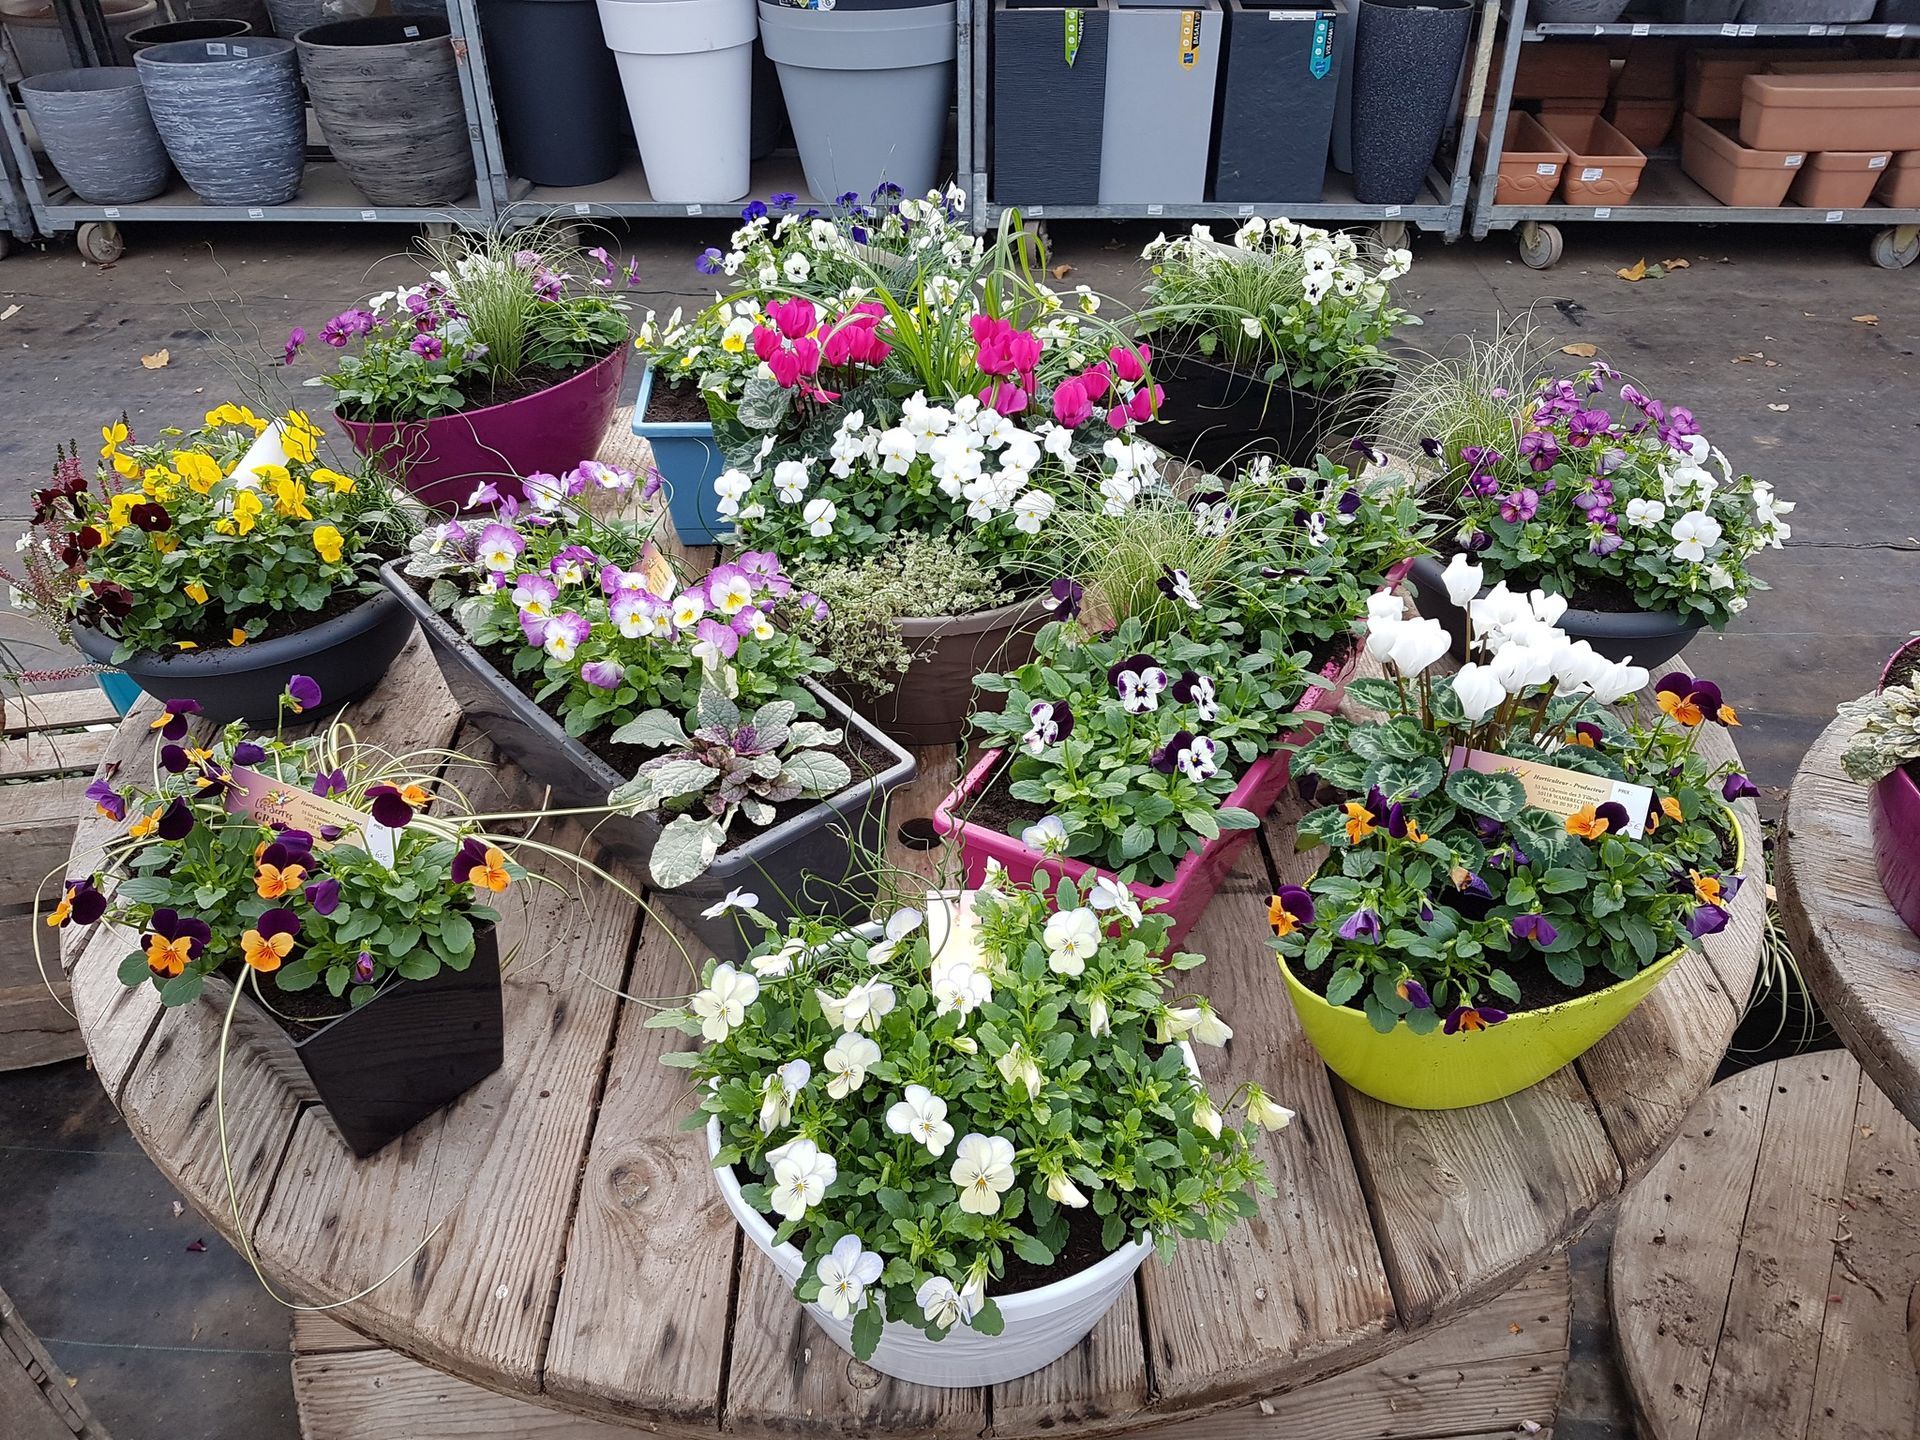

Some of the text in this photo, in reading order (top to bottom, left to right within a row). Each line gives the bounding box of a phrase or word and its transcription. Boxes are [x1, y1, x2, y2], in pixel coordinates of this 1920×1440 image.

[1192, 21, 1200, 45] BASALT
[1533, 774, 1569, 786] Horticulteur
[1573, 782, 1605, 794] Producteur
[255, 797, 293, 821] Les Serres
[300, 800, 332, 816] Horticulteur
[335, 813, 363, 827] Producteur
